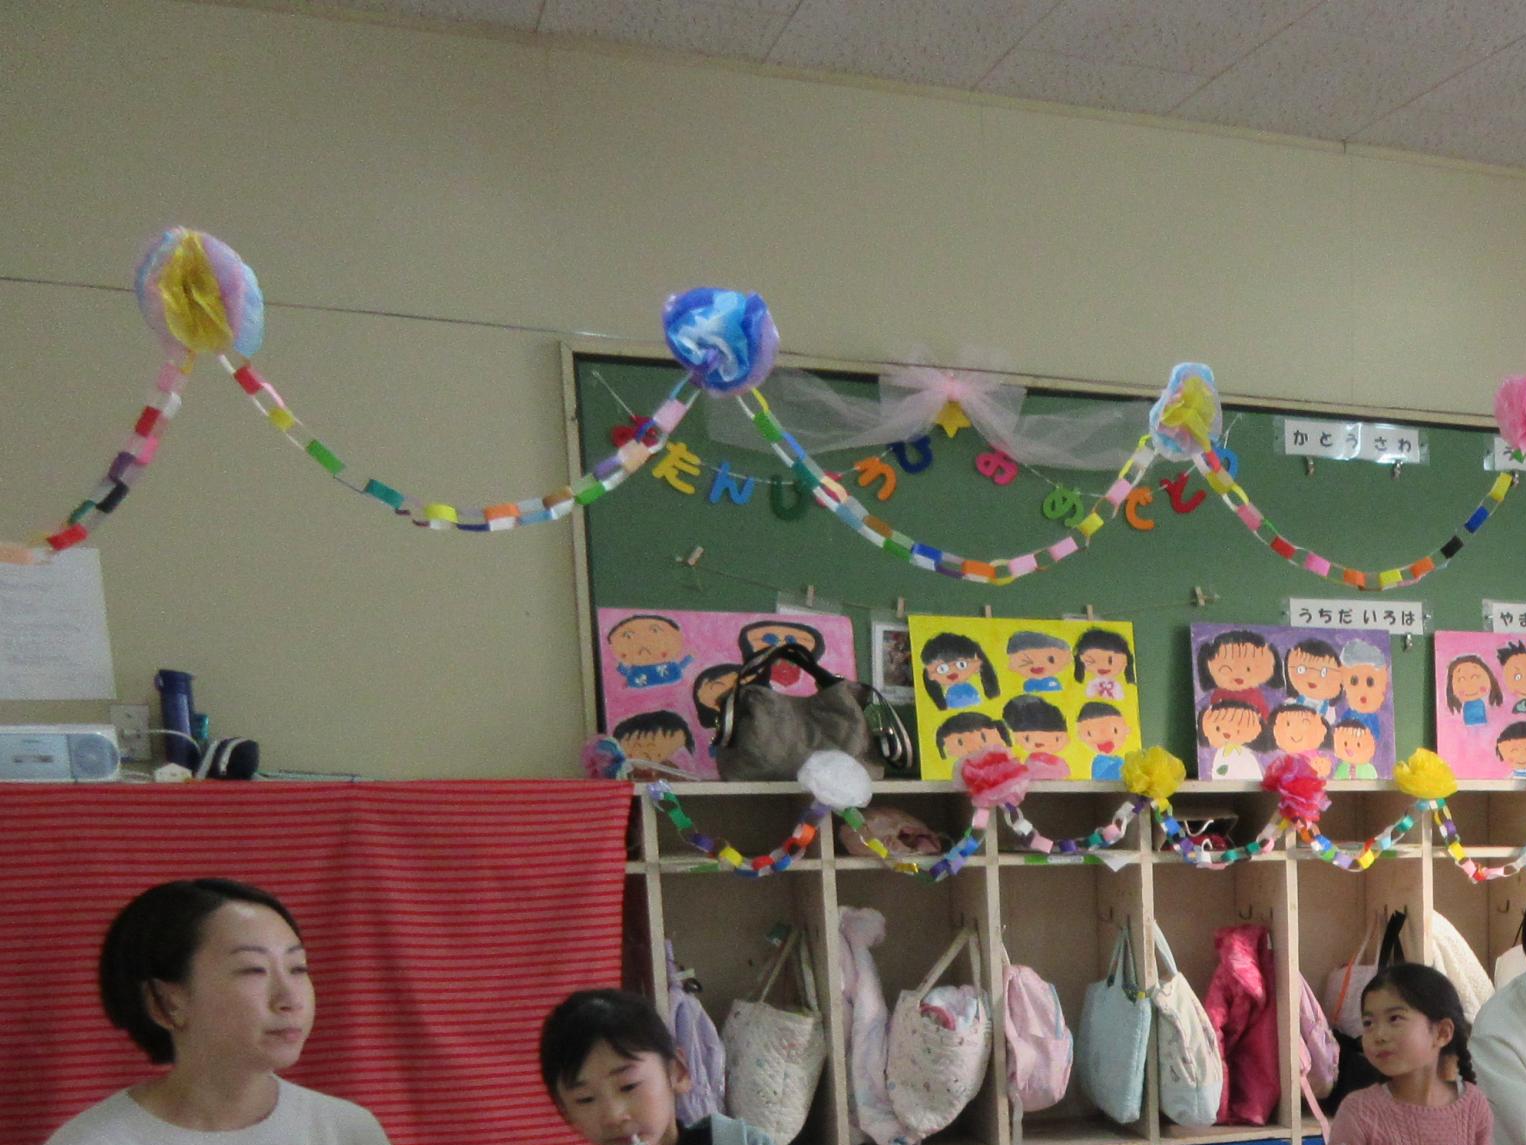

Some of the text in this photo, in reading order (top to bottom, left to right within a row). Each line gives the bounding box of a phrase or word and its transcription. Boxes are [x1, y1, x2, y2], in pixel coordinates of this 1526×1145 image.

[1293, 429, 1412, 453] かとう さわ
[1298, 608, 1415, 626] うちだ いろは
